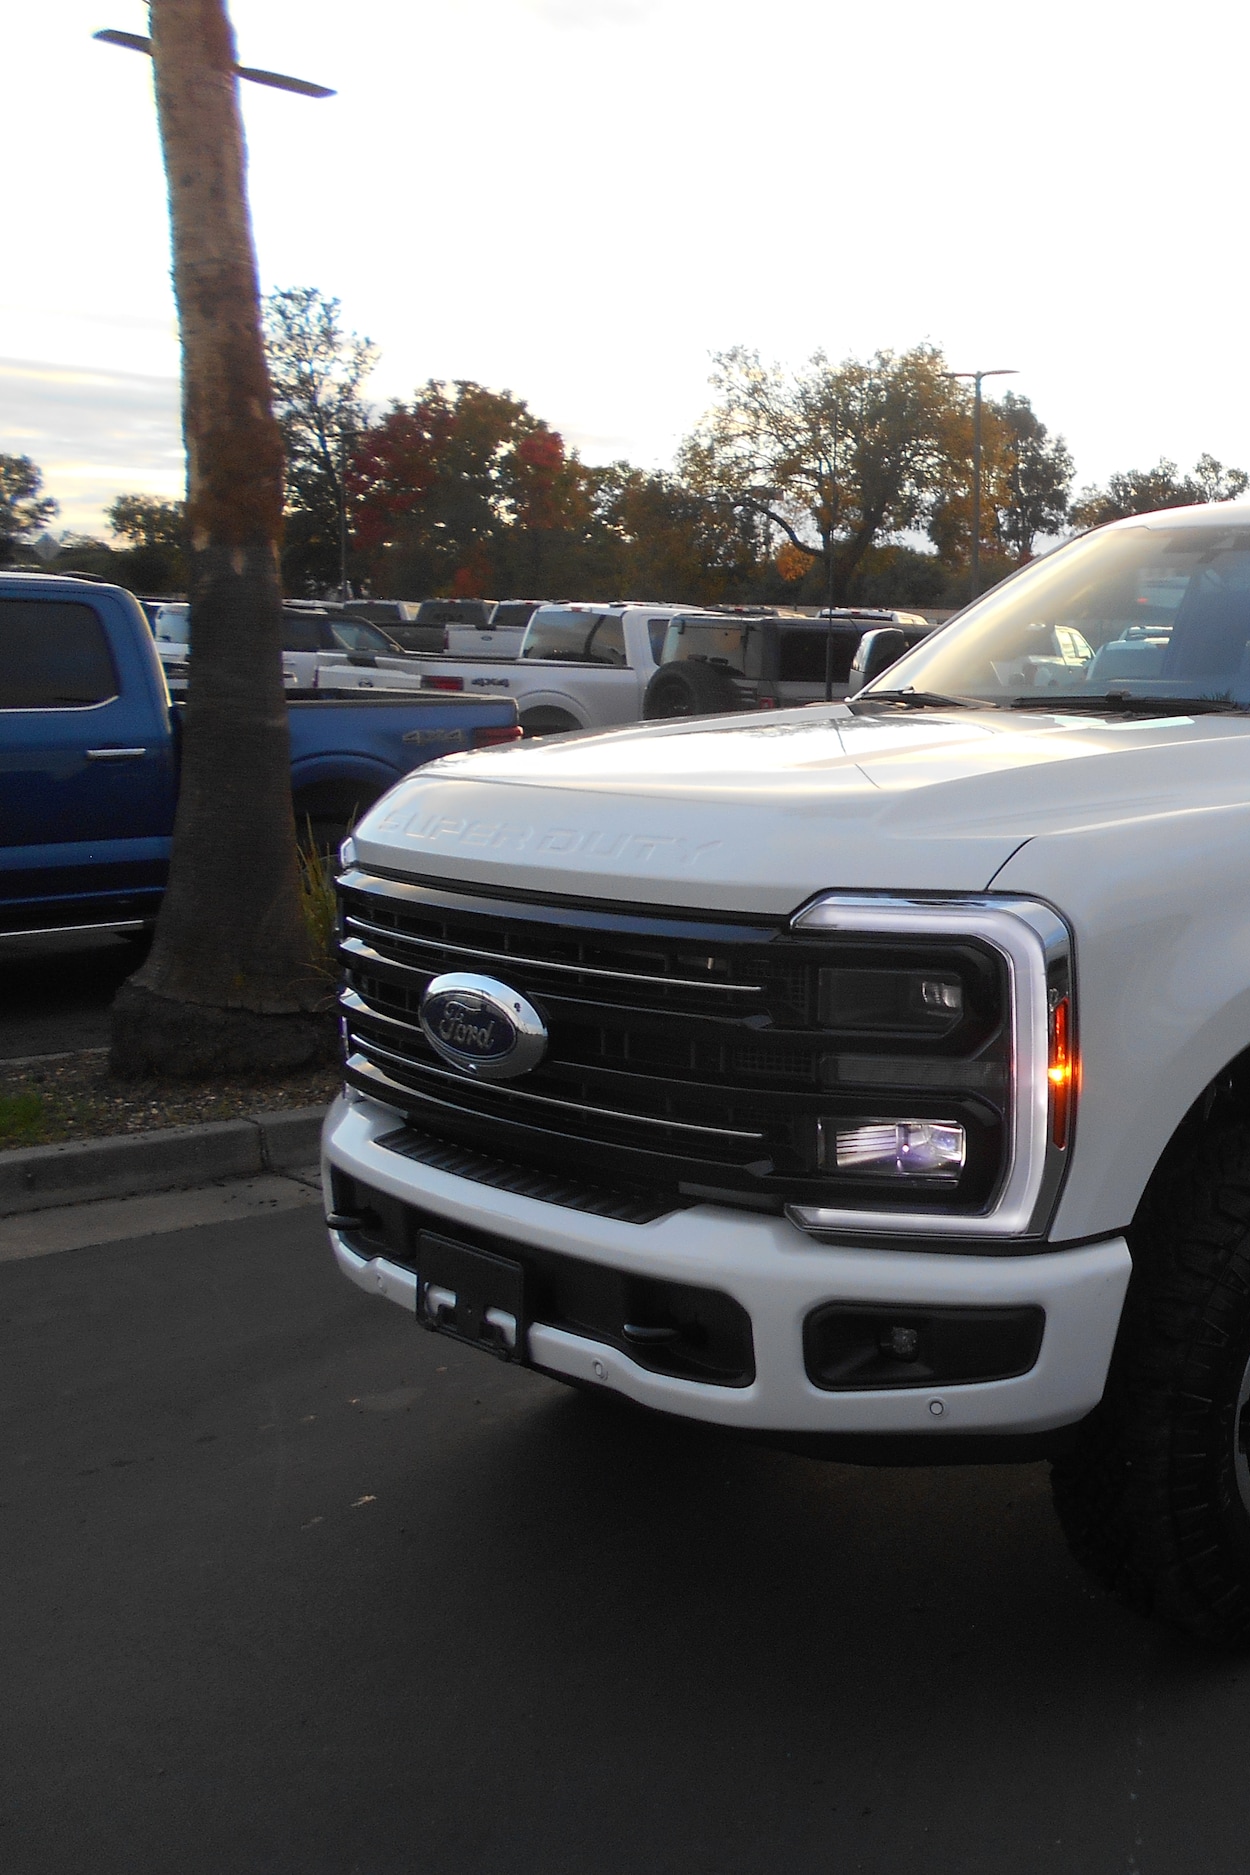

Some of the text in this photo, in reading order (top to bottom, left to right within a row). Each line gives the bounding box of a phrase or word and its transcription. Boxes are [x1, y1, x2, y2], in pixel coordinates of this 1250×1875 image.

[378, 809, 723, 866] SUPER DUTY
[441, 1001, 495, 1049] Ford
